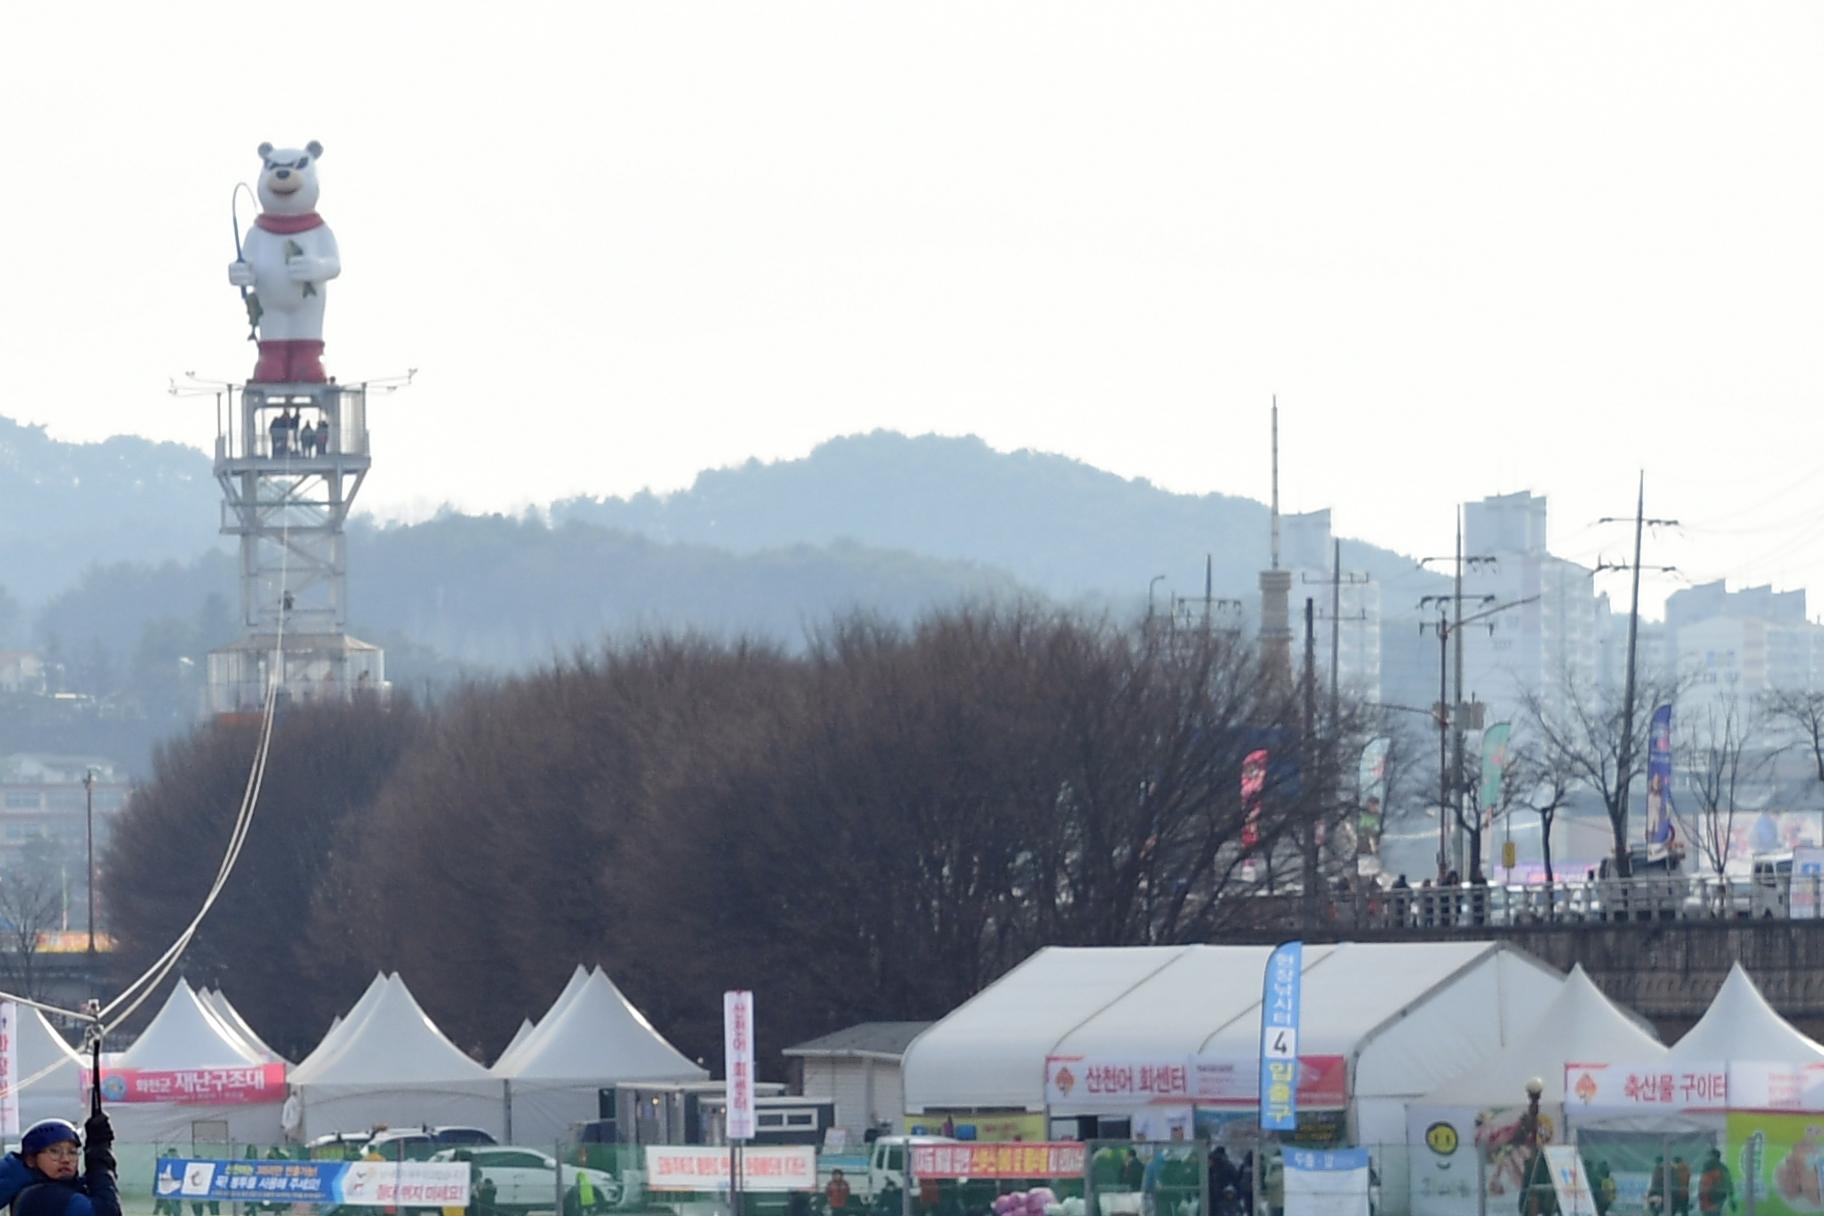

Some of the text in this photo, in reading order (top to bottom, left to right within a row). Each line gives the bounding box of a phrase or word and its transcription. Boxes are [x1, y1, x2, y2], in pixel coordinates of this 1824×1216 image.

[1272, 1030, 1288, 1055] 4
[135, 1070, 266, 1094] 화천군 재난구조대
[1085, 1064, 1133, 1094] 산천어
[1138, 1064, 1188, 1094] 회센터
[1624, 1072, 1729, 1102] 축산물 구이터
